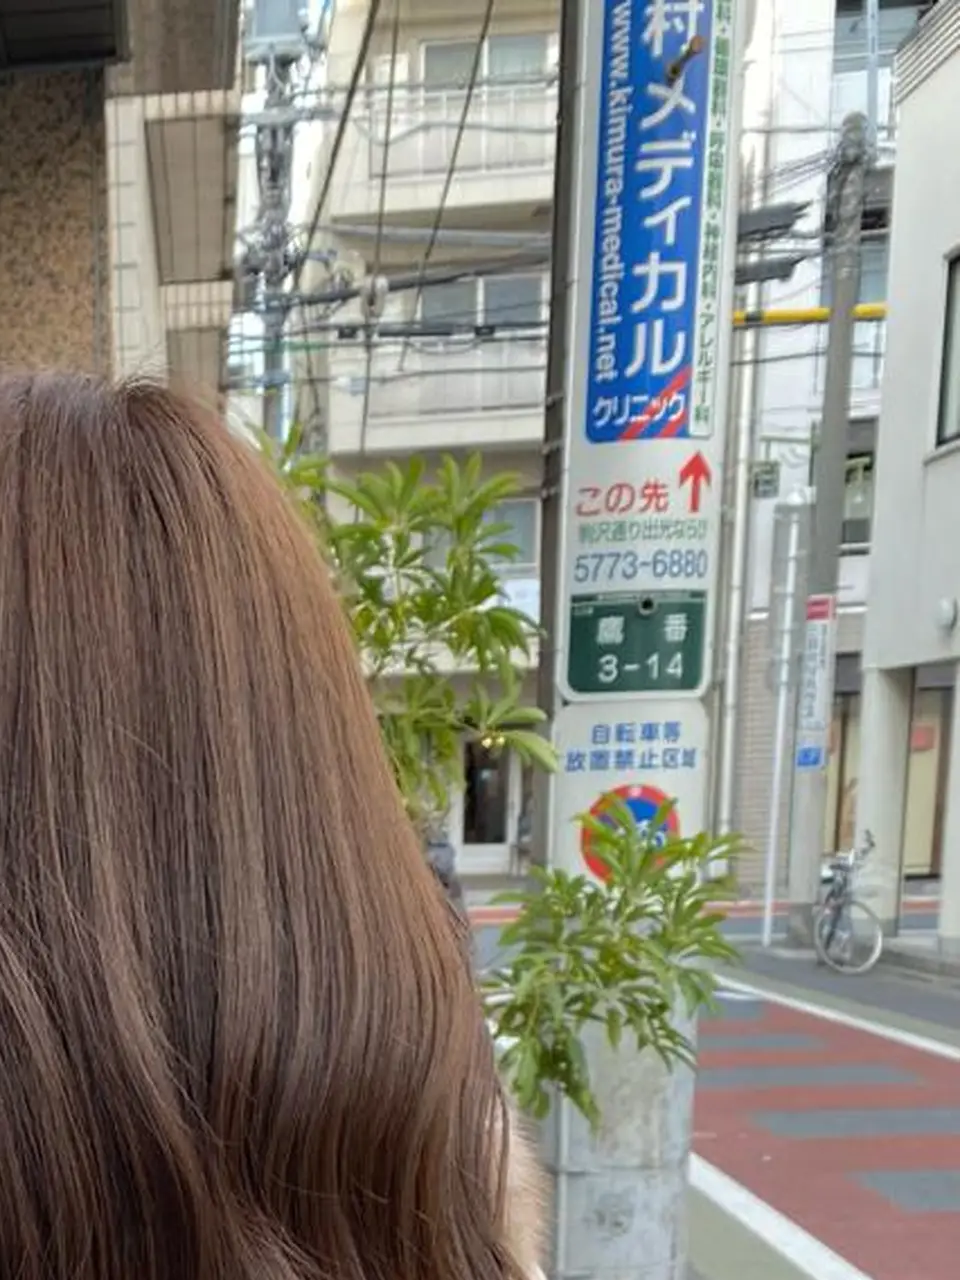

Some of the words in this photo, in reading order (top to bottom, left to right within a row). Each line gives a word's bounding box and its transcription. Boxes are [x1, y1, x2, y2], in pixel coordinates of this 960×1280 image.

[593, 391, 688, 427] クリニック
[575, 479, 670, 517] この先
[573, 548, 709, 583] 5773-6880
[597, 651, 684, 684] 3-14
[591, 720, 682, 745] 自転車等
[564, 747, 698, 773] 放置禁止区域
